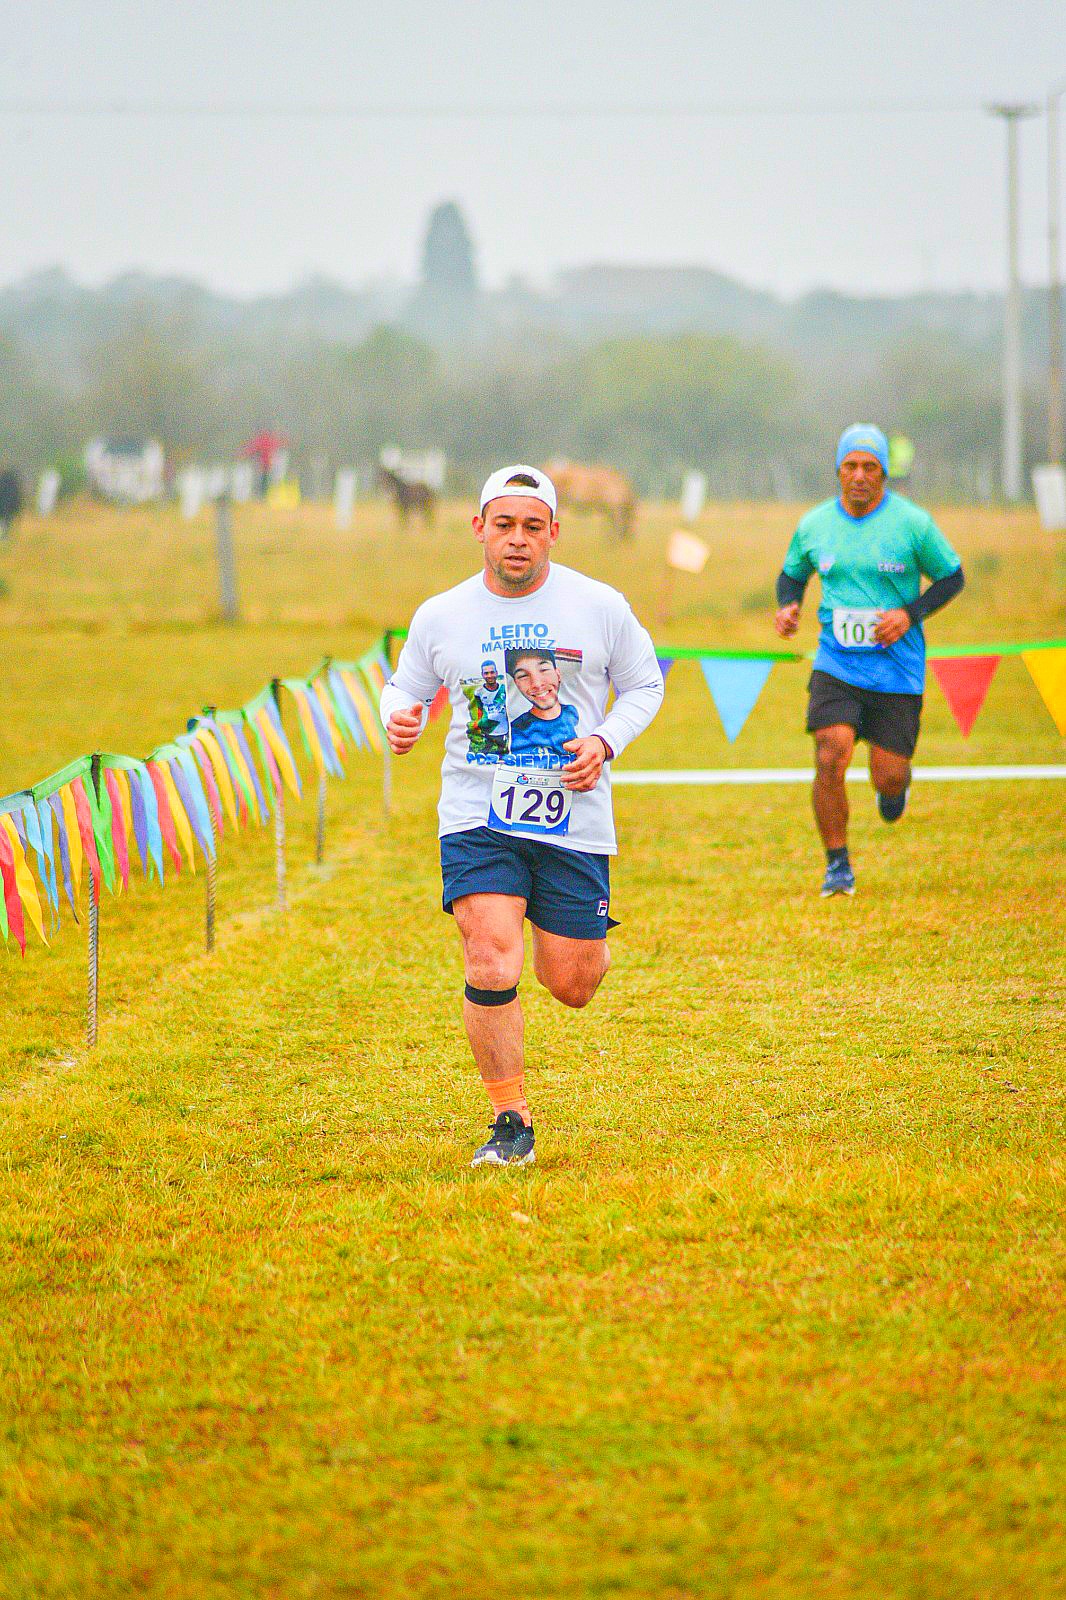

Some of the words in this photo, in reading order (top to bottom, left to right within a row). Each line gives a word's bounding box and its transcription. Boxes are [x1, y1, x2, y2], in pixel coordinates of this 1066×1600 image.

[490, 623, 548, 641] LEITO
[481, 638, 556, 653] MARTINEZ
[466, 752, 499, 765] POR
[500, 786, 565, 824] 129
